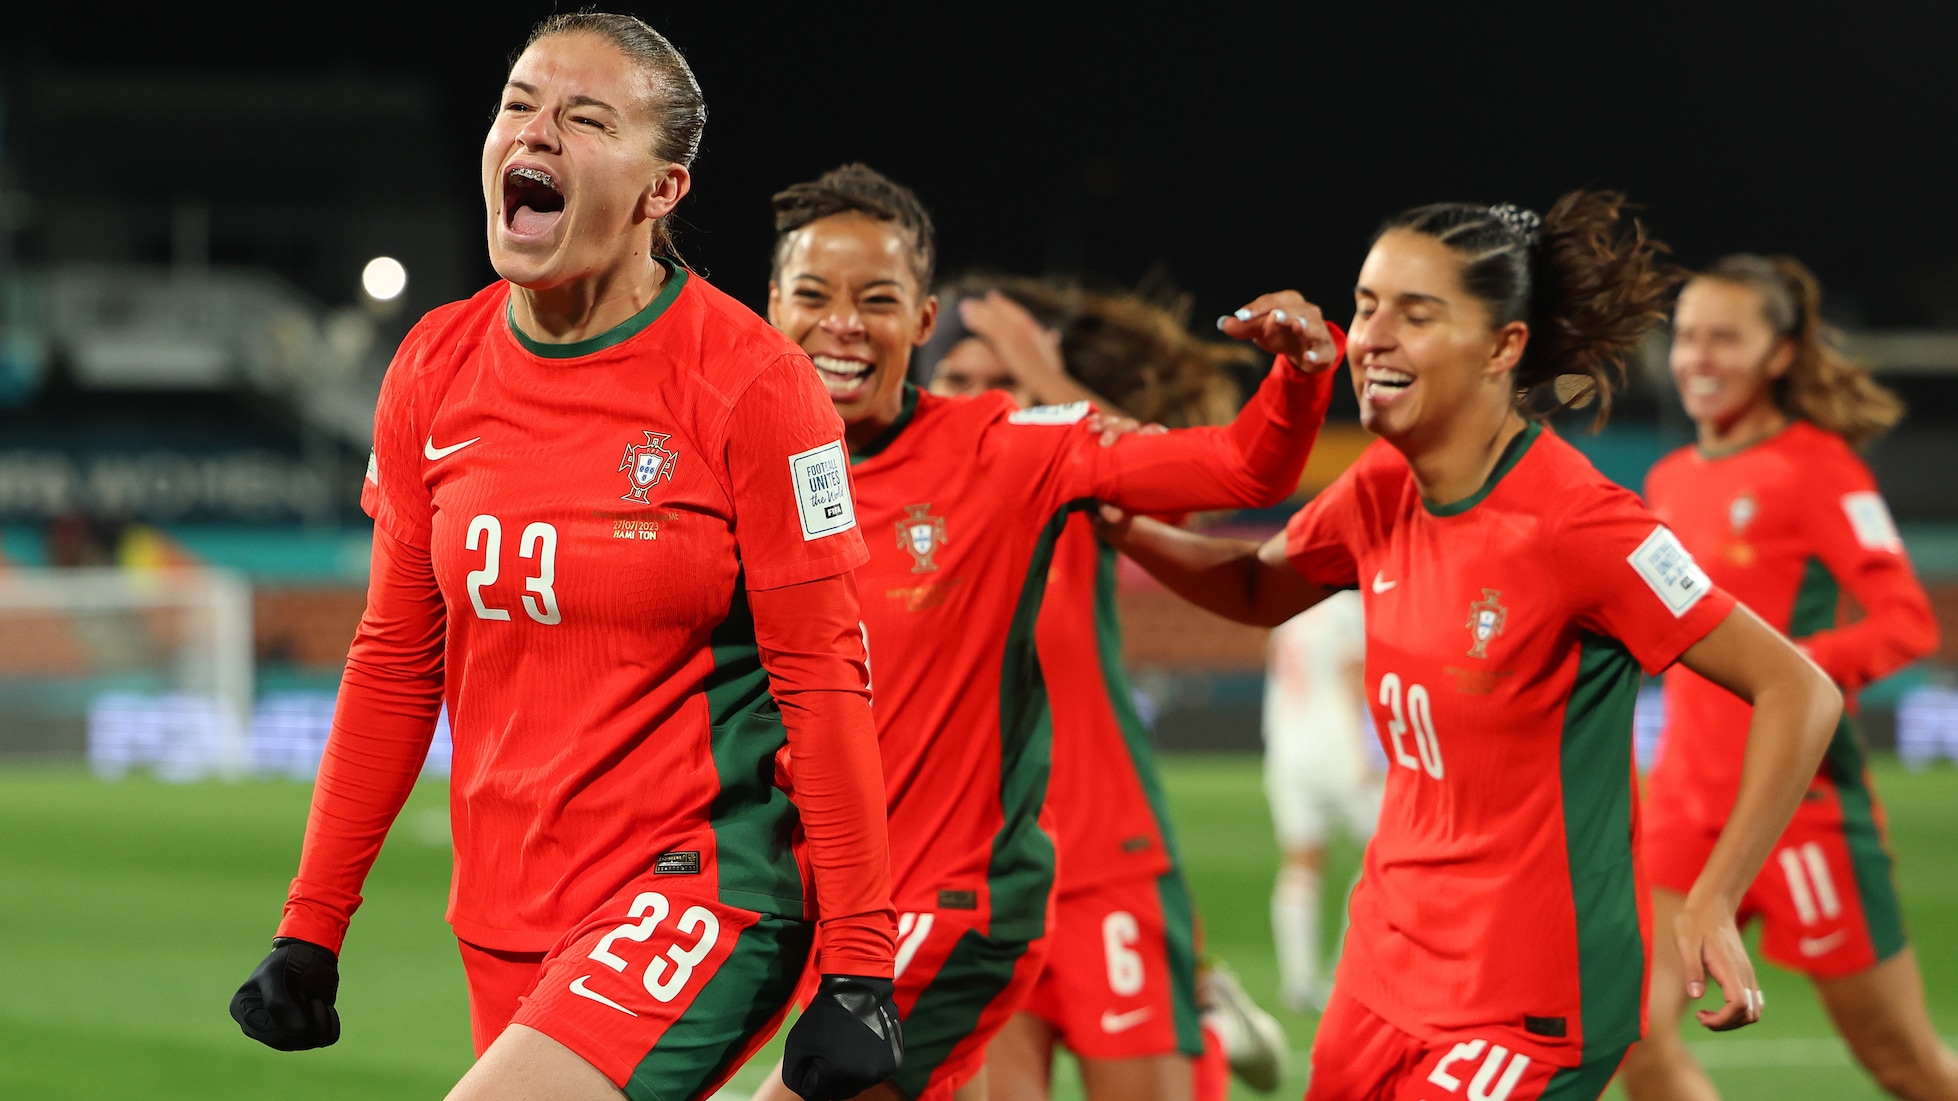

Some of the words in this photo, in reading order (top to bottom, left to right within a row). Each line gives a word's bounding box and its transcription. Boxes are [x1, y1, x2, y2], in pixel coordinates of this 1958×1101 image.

[806, 459, 838, 477] FOOTBALL
[808, 470, 841, 493] UNITES
[810, 492, 827, 507] the
[825, 506, 842, 518] FIFA
[613, 520, 659, 531] 27/07/2023
[613, 530, 657, 540] HAMITON
[465, 514, 562, 625] 23
[1379, 672, 1444, 780] 20
[1778, 842, 1840, 926] 11
[588, 892, 720, 1003] 23
[1102, 911, 1145, 997] 6
